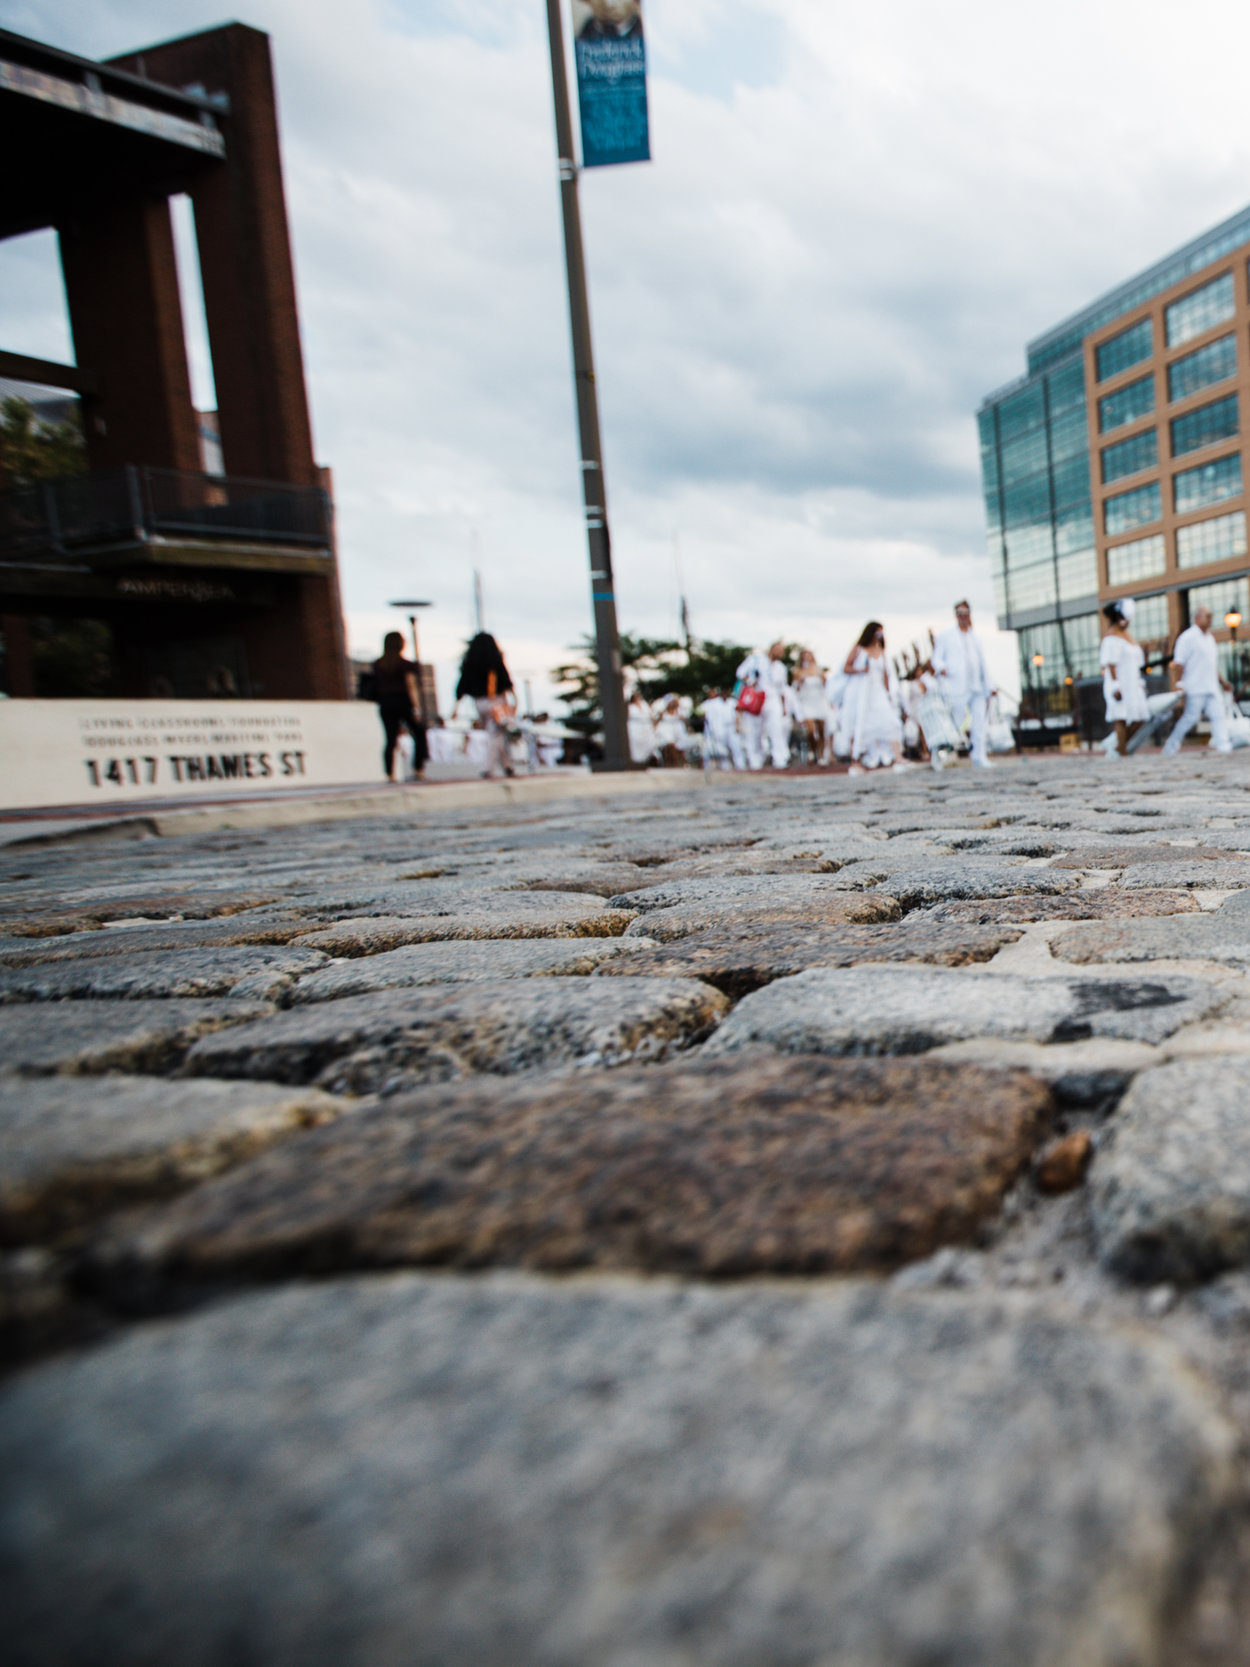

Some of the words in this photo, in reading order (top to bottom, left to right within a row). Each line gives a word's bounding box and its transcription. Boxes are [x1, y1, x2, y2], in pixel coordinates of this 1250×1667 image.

[86, 756, 158, 786] 1417
[169, 752, 272, 782] THAMES
[281, 751, 306, 776] ST
